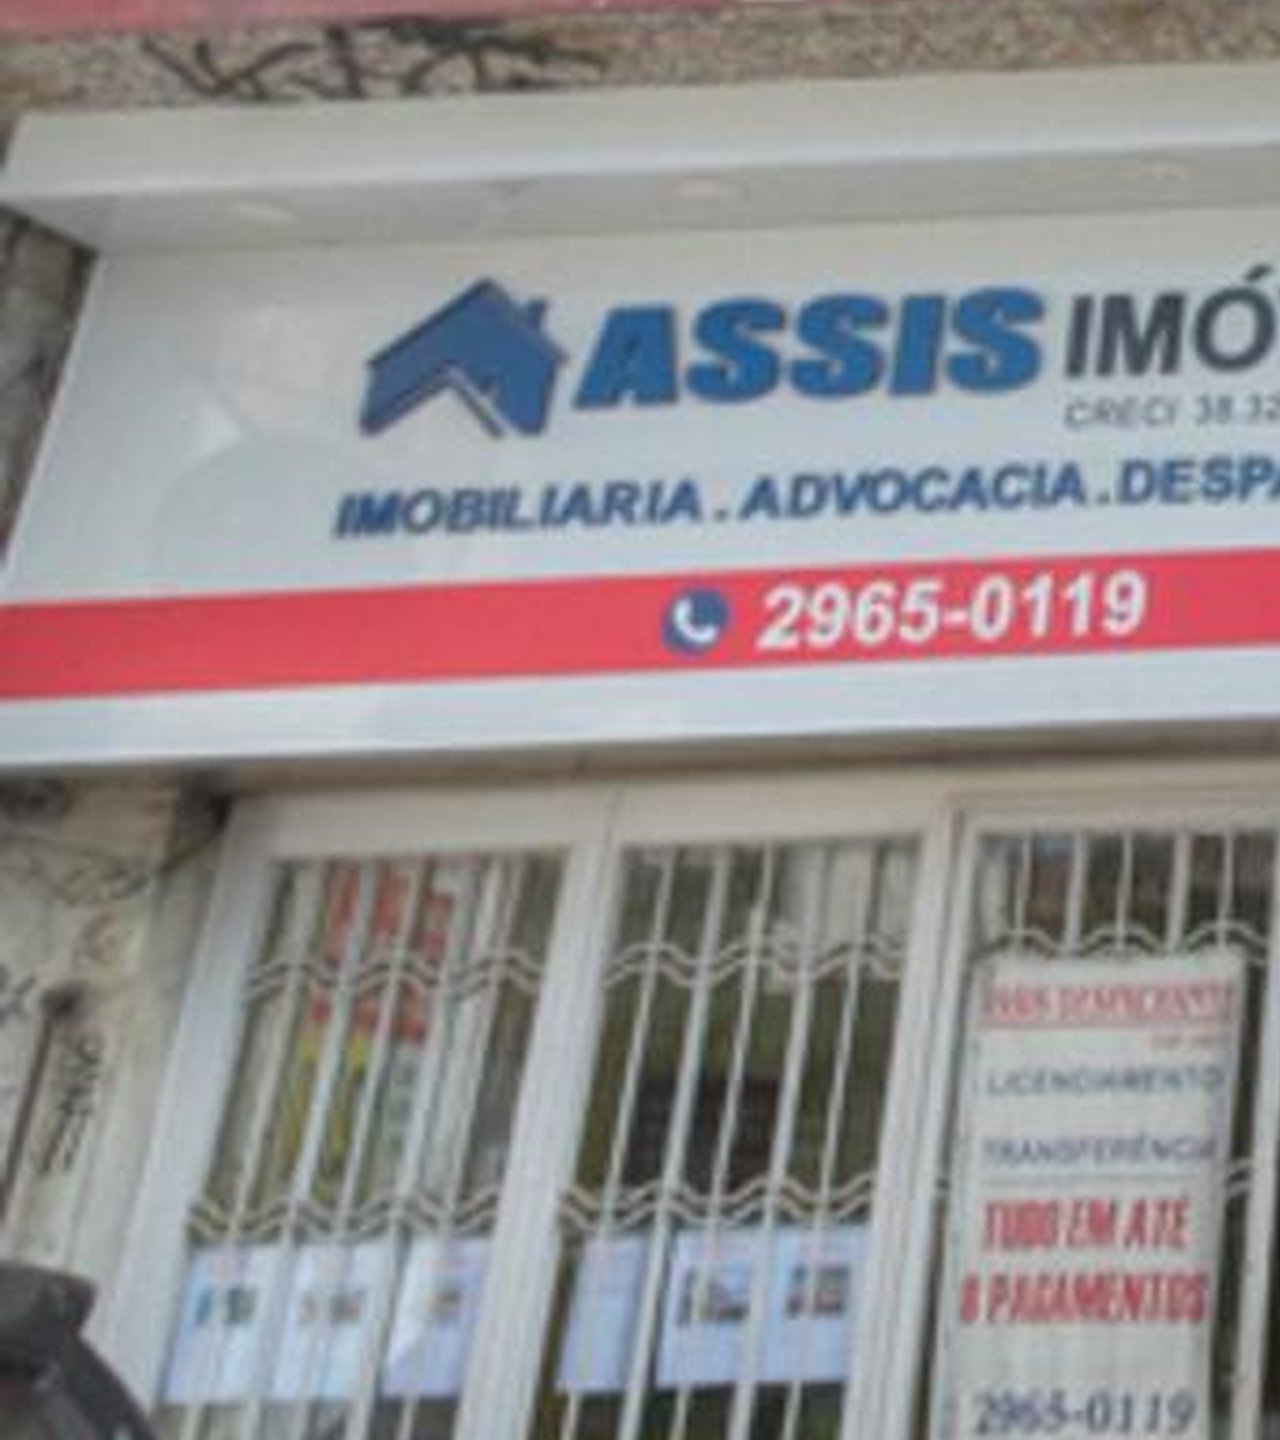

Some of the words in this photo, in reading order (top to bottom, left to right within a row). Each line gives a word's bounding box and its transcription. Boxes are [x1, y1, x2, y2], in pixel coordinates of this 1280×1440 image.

[573, 286, 1047, 410] ASSIS
[756, 569, 1148, 653] 2965-0119
[1064, 1198, 1118, 1251] EM
[987, 1270, 1209, 1324] PAGAMENTOS
[972, 1386, 1198, 1438] 2965-0119
